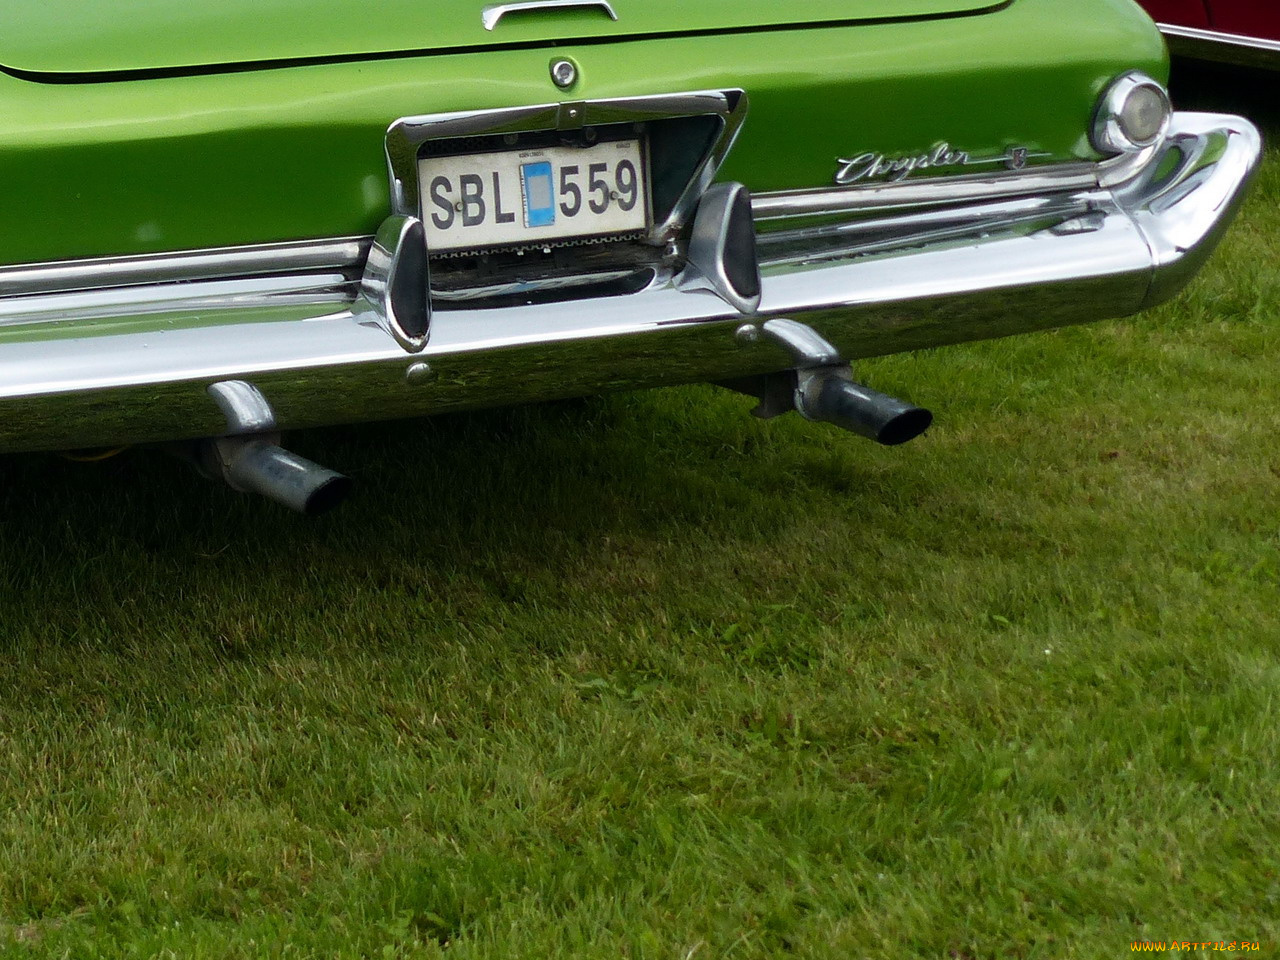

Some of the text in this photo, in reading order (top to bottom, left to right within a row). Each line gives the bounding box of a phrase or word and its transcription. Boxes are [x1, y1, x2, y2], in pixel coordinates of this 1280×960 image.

[835, 141, 970, 184] Chrysler
[429, 158, 638, 231] SBL 559
